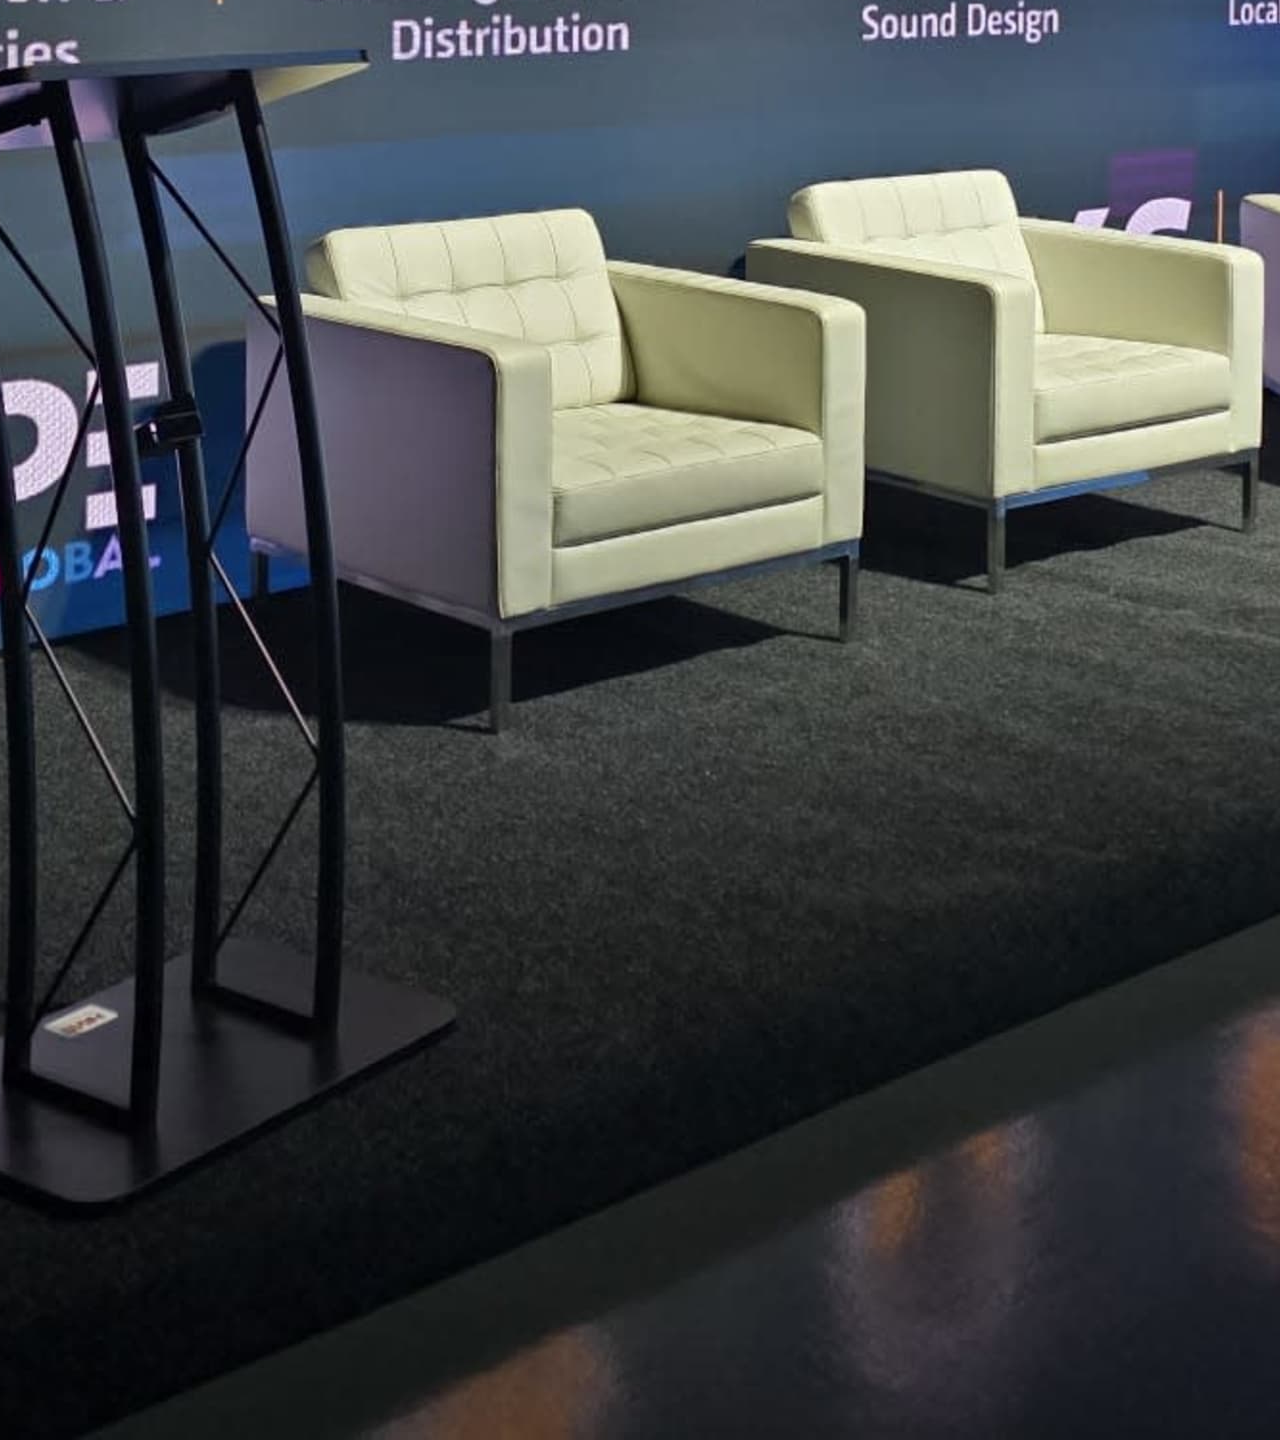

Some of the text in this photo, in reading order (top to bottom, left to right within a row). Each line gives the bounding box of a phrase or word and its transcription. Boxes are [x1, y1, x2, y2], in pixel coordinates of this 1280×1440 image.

[392, 12, 629, 61] Distribution
[861, 0, 1060, 43] Sound Design
